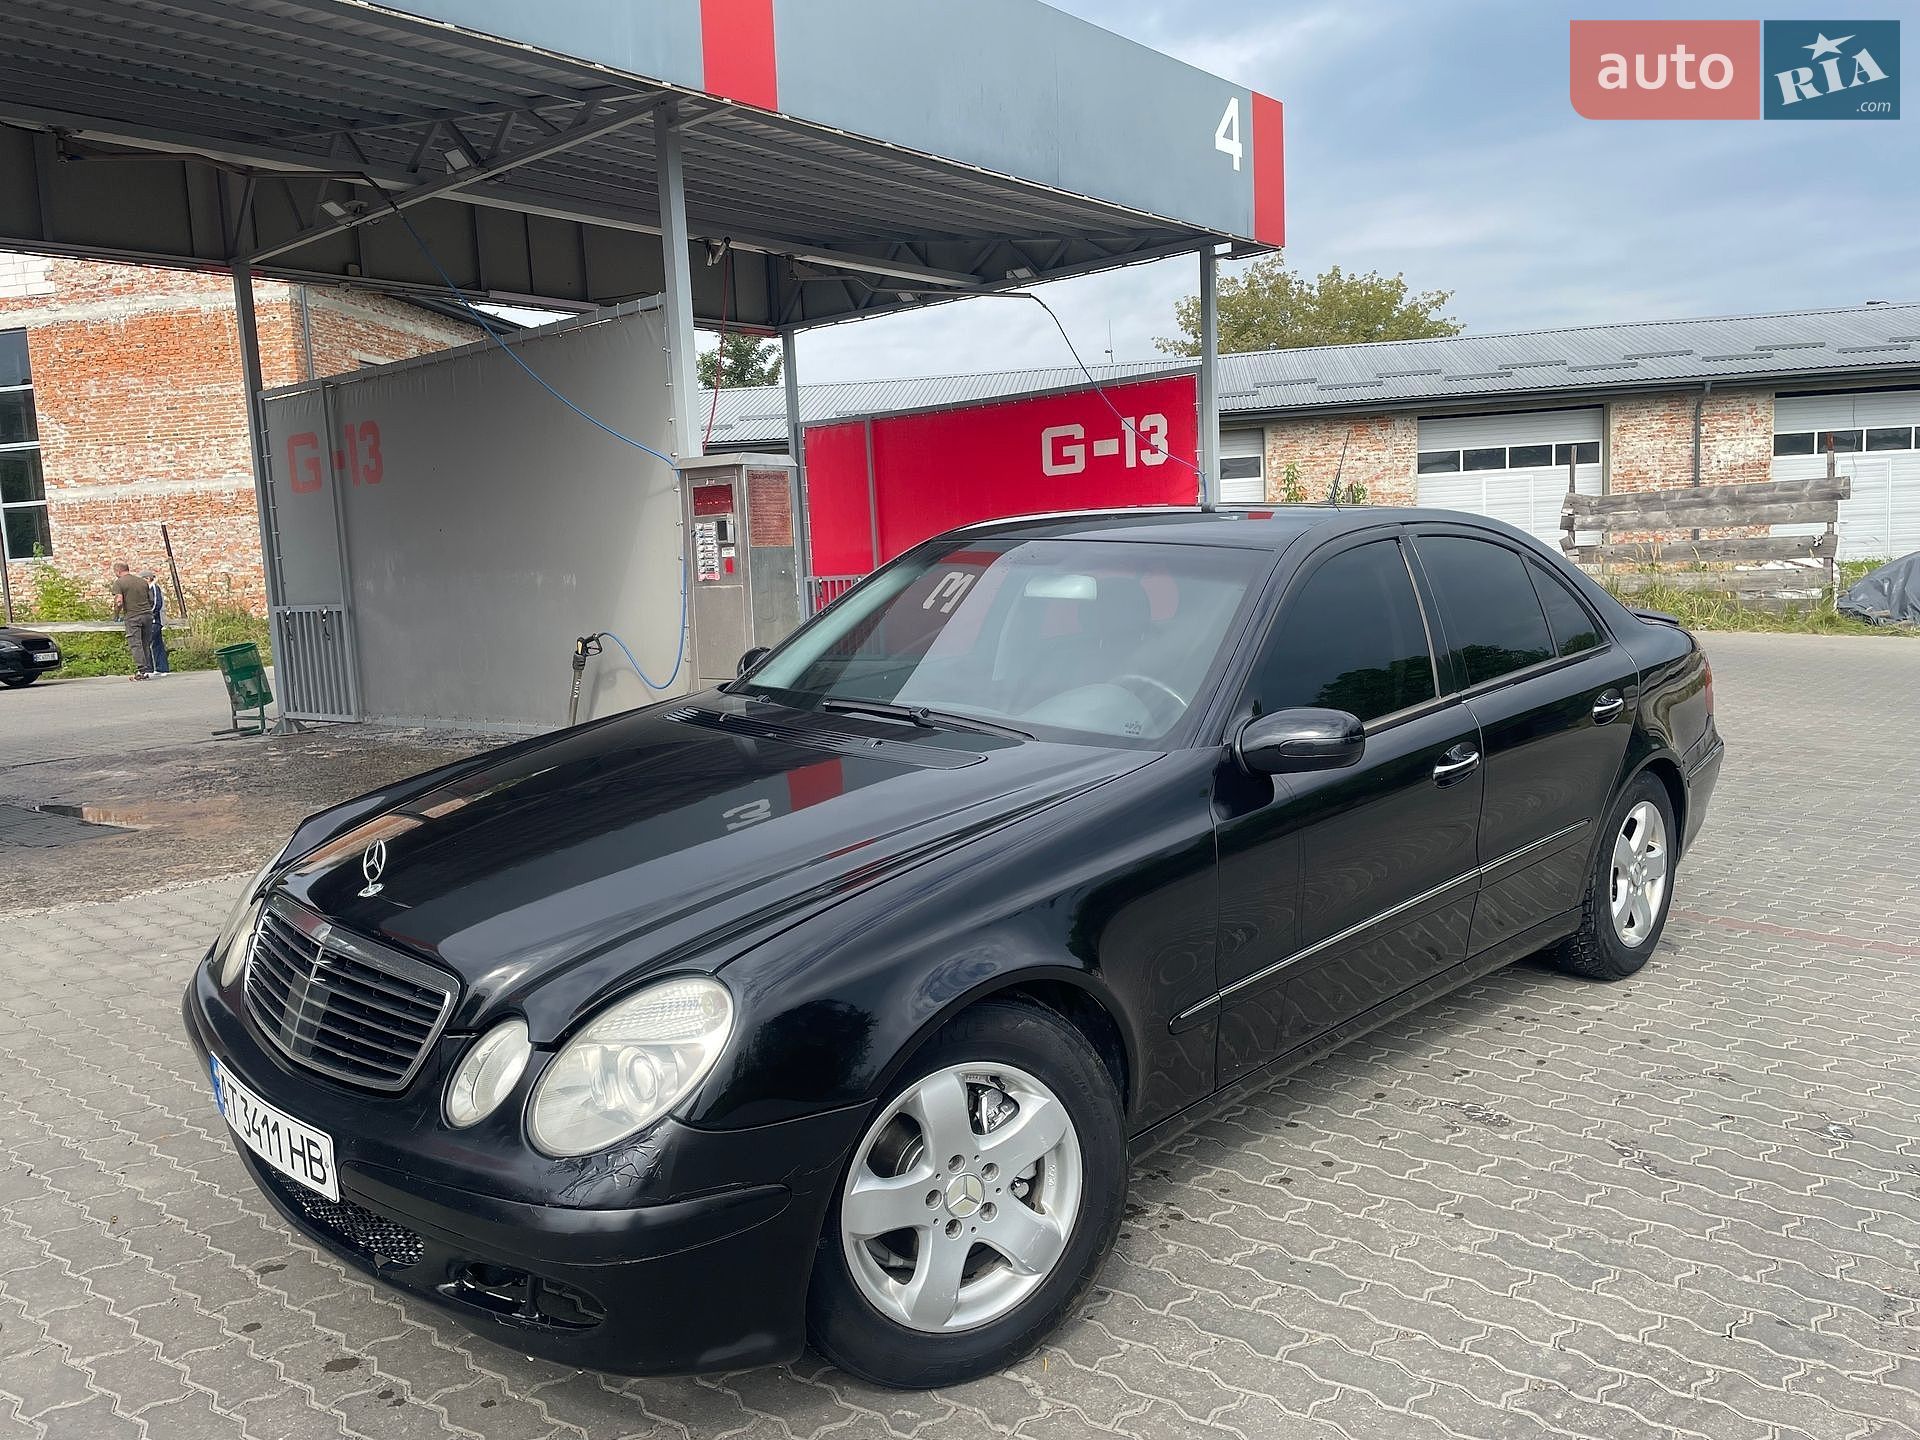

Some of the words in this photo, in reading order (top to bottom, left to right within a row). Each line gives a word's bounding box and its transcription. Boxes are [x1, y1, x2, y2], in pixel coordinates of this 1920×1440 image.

[1215, 96, 1242, 171] 4
[287, 420, 383, 495] G-13
[1041, 413, 1168, 476] G-13
[220, 1074, 237, 1124] AT
[241, 1095, 283, 1163] 3411
[287, 1128, 327, 1185] HB
